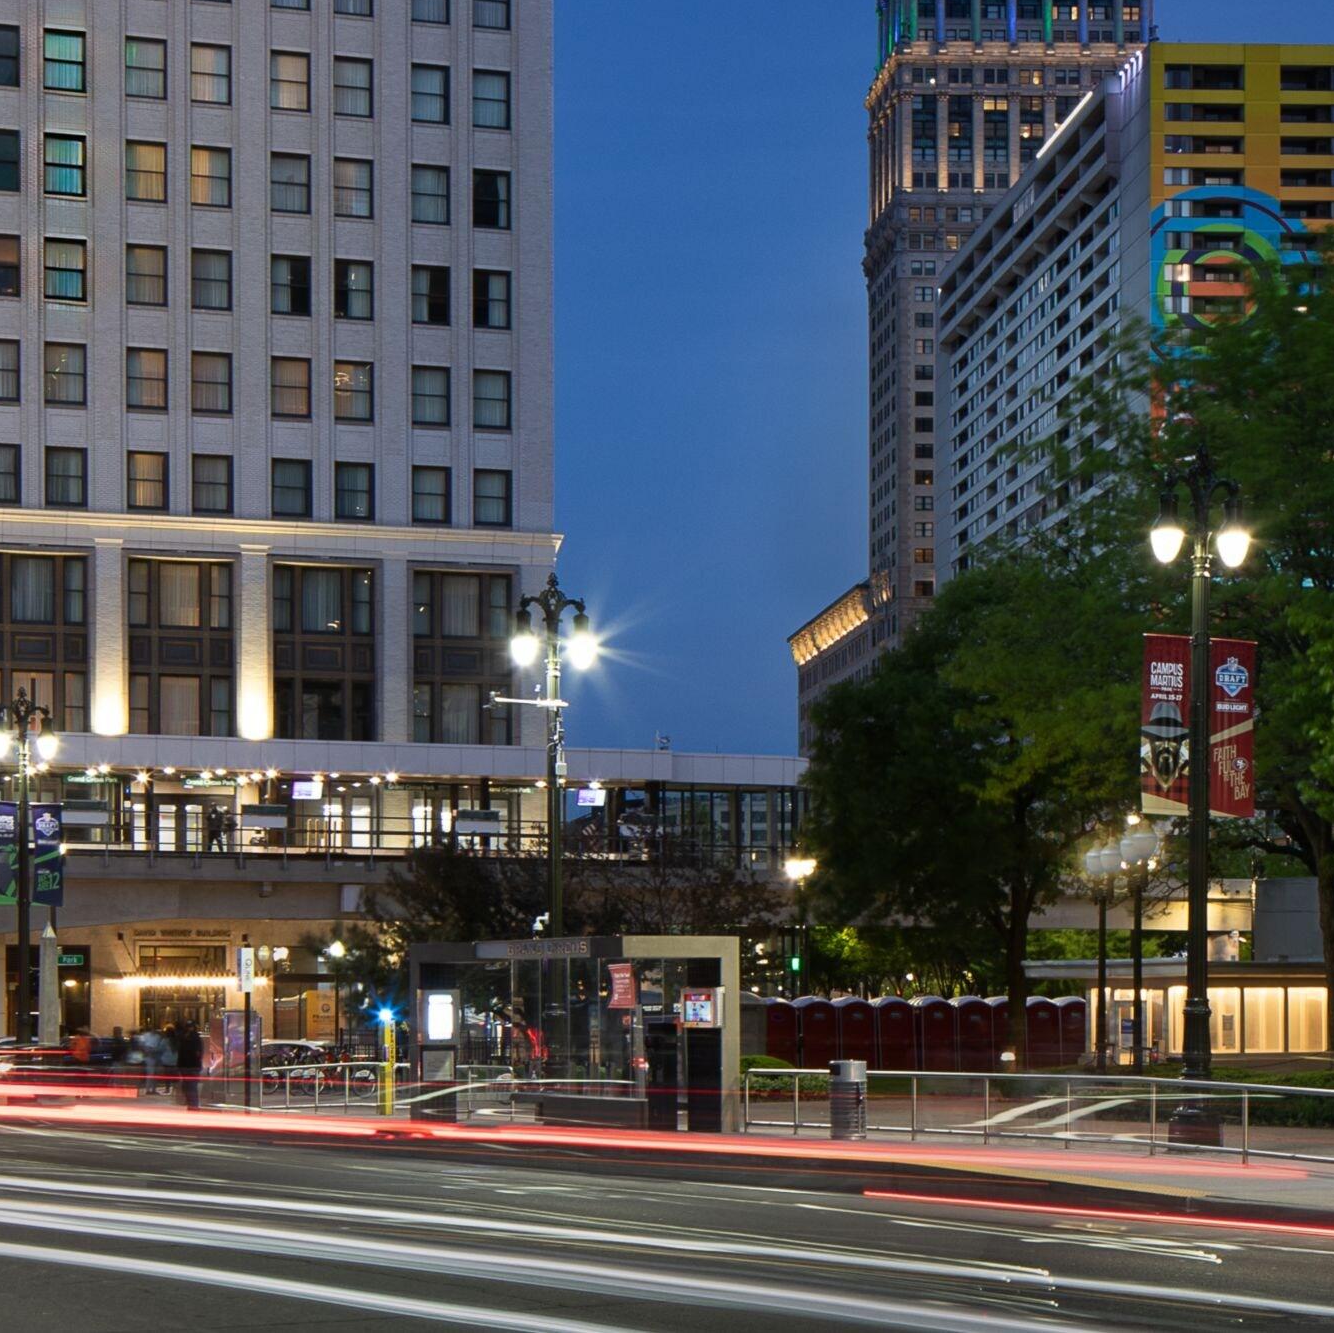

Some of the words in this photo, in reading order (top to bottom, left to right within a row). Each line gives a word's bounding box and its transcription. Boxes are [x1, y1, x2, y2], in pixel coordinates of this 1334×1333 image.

[1150, 661, 1183, 675] CAMPUS
[1150, 674, 1183, 688] MARTIUS
[1218, 674, 1245, 683] DRAFT
[1214, 745, 1236, 762] FAITH
[67, 775, 85, 783] Grand
[1230, 770, 1246, 787] THE
[1234, 783, 1251, 801] BAY
[546, 941, 588, 954] CIRCUS
